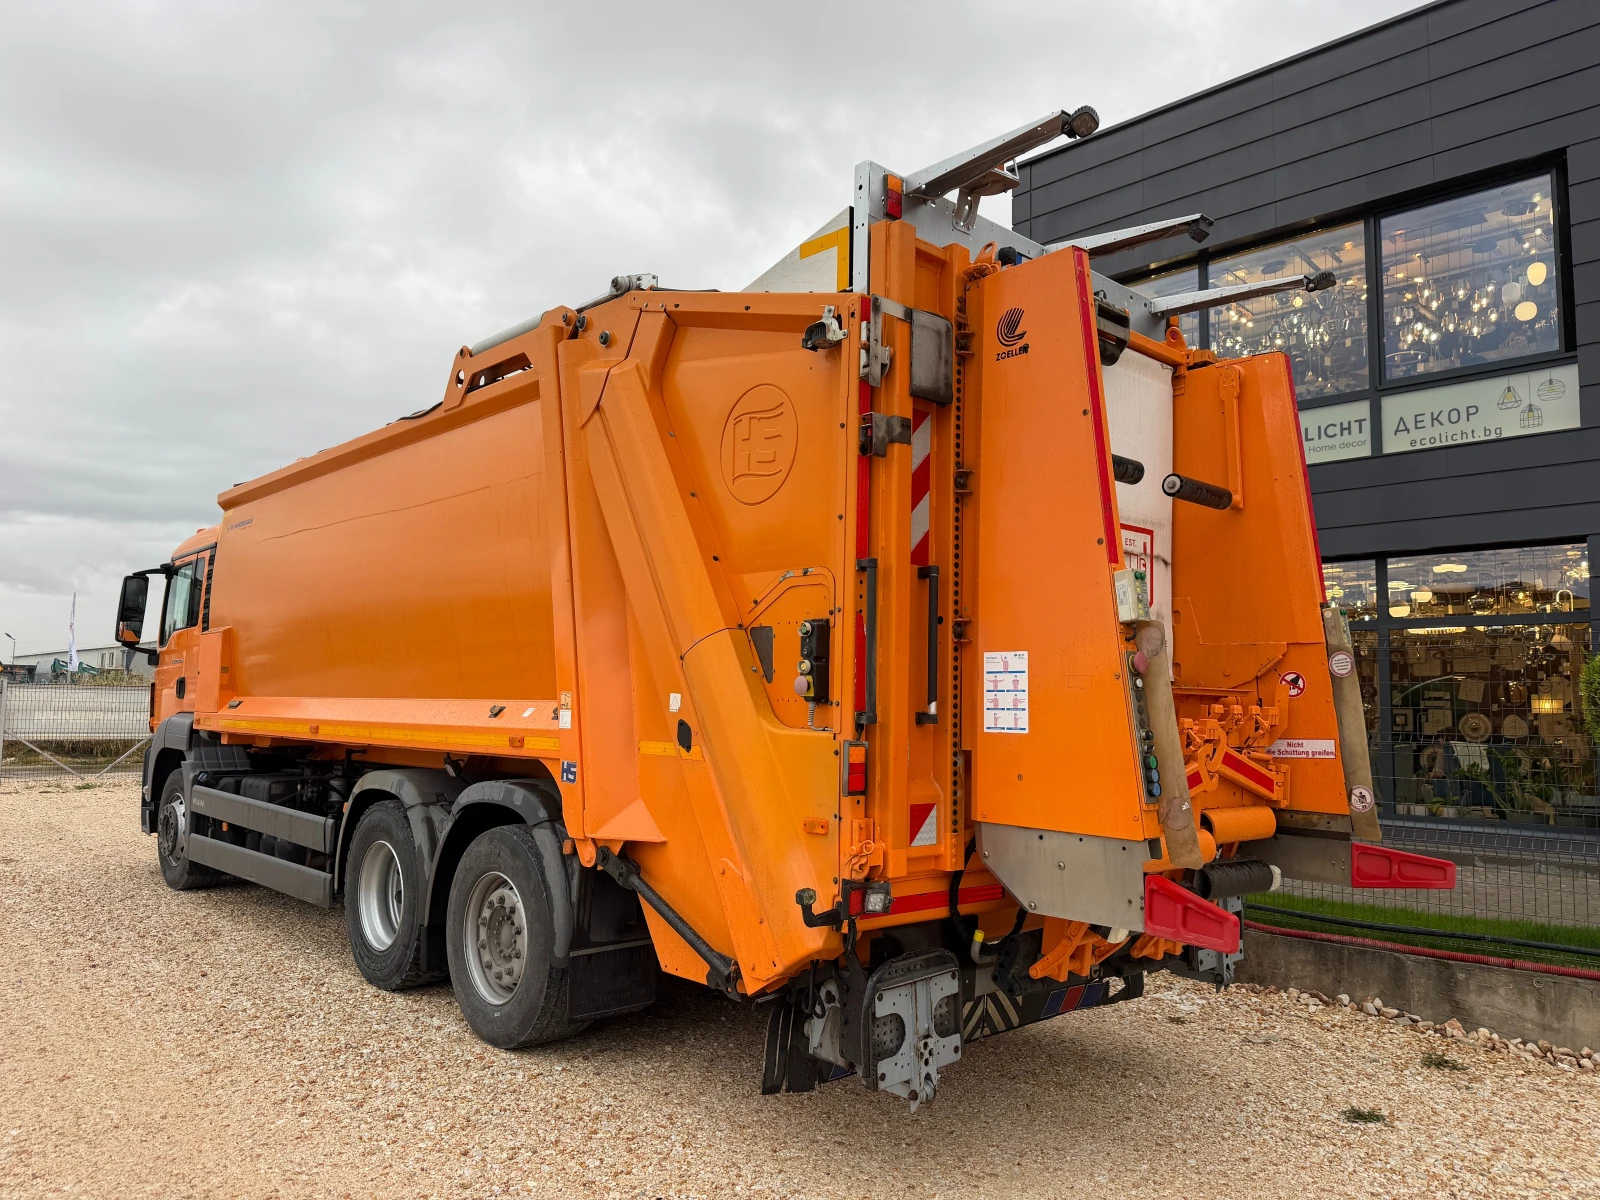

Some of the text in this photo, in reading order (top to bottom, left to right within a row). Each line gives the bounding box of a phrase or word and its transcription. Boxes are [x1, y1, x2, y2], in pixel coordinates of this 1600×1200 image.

[995, 343, 1030, 361] ZOELLER
[1304, 418, 1367, 442] LICHT
[1394, 405, 1479, 436] ДЕКОР
[1308, 440, 1367, 453] Home decor
[1409, 426, 1503, 447] ecolicht.bg
